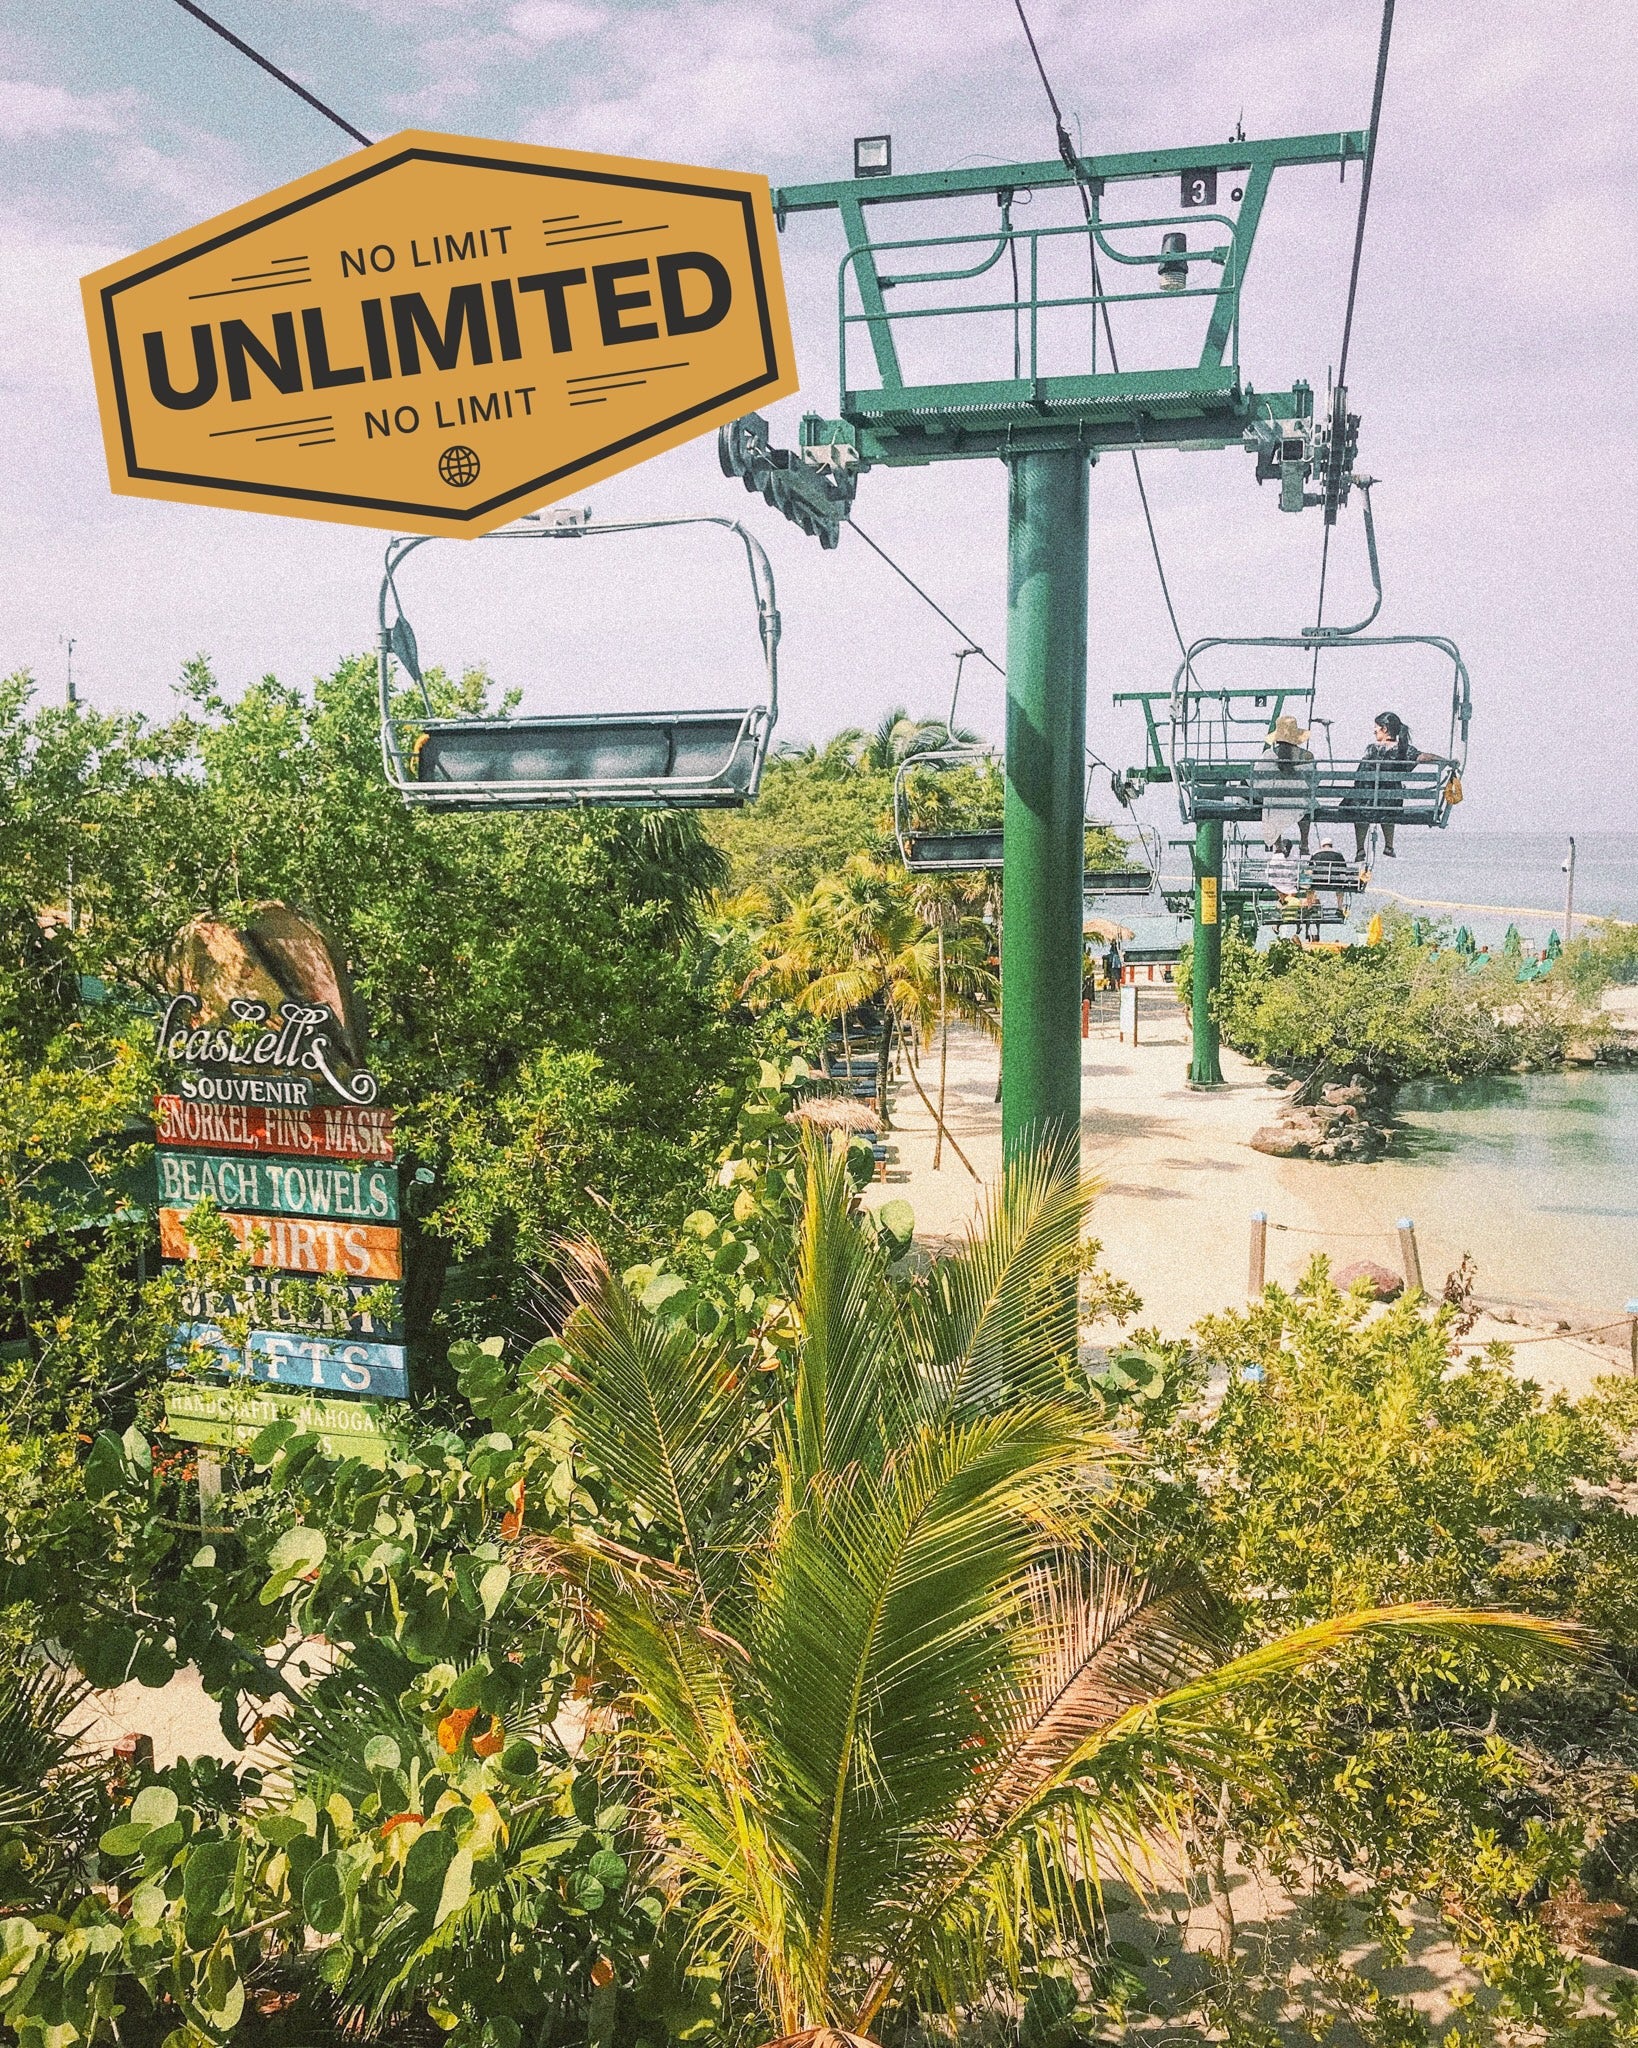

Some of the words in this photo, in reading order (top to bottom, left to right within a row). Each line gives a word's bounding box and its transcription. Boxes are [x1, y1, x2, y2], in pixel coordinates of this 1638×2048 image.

[1191, 179, 1206, 204] 3
[1258, 697, 1264, 707] 2
[181, 1077, 308, 1106] SOUVENIR
[158, 1097, 260, 1150] SNORKEL,
[265, 1107, 319, 1155] FINS,
[162, 1158, 259, 1206] BEACH
[265, 1165, 389, 1217] TOWELS
[299, 1407, 394, 1435] MAHOGAN
